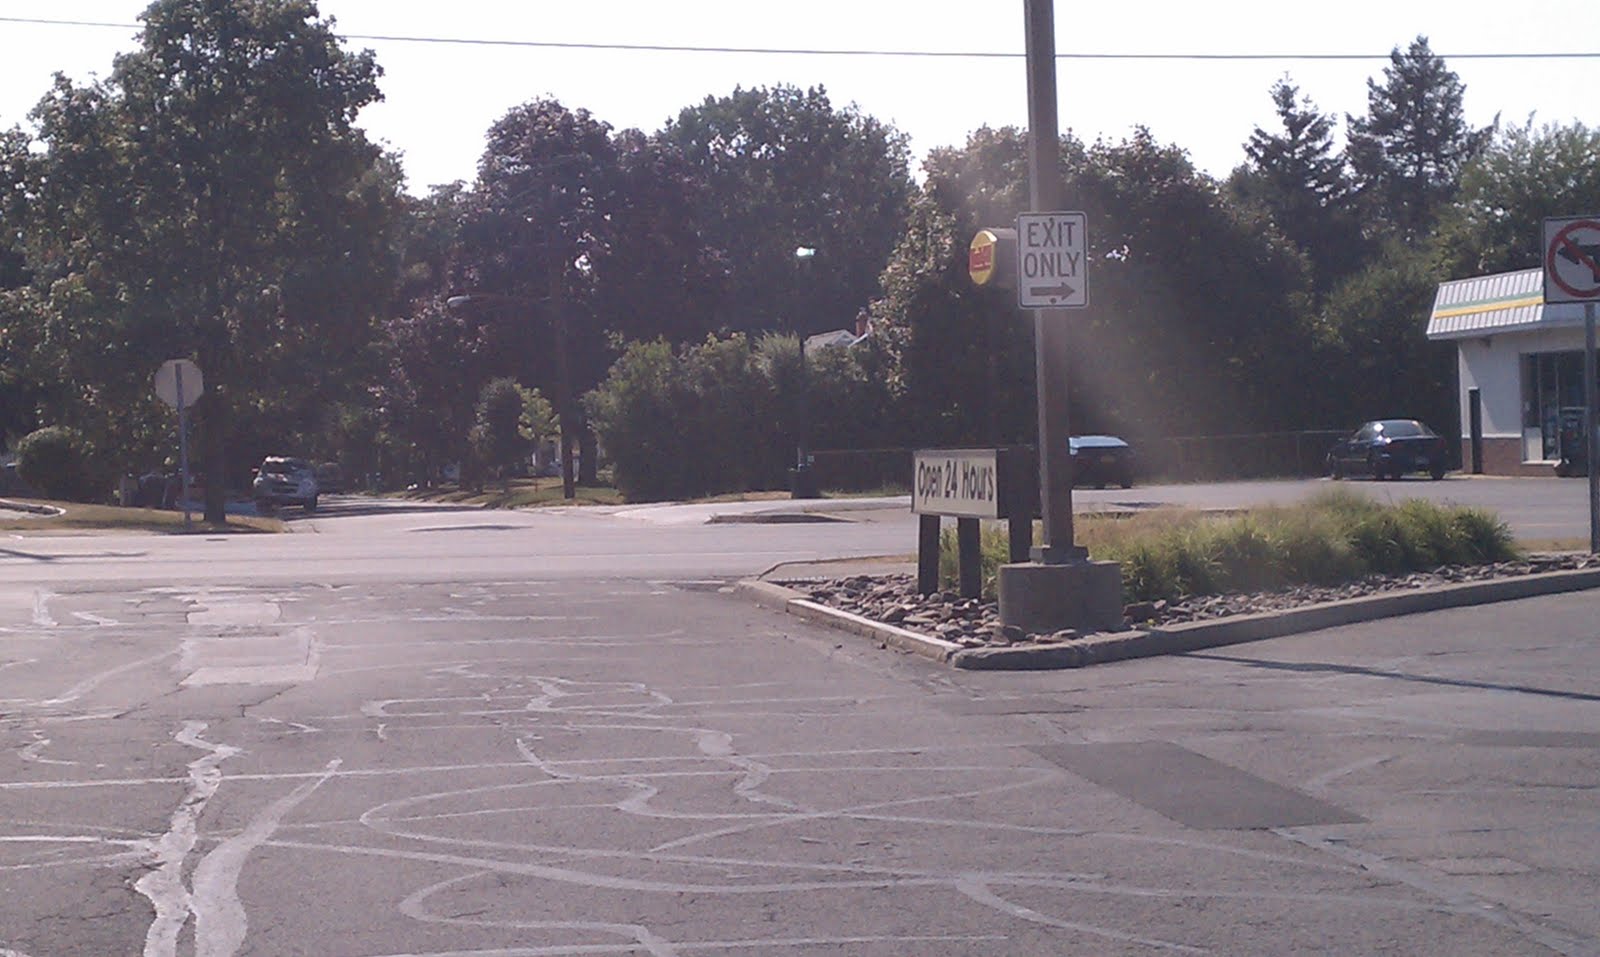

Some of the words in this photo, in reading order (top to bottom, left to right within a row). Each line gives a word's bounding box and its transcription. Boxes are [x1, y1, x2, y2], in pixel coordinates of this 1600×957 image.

[1027, 222, 1076, 247] EXIT
[1024, 252, 1080, 278] ONLY
[918, 461, 943, 505] Open
[945, 460, 957, 499] 24
[962, 461, 994, 502] Hours
